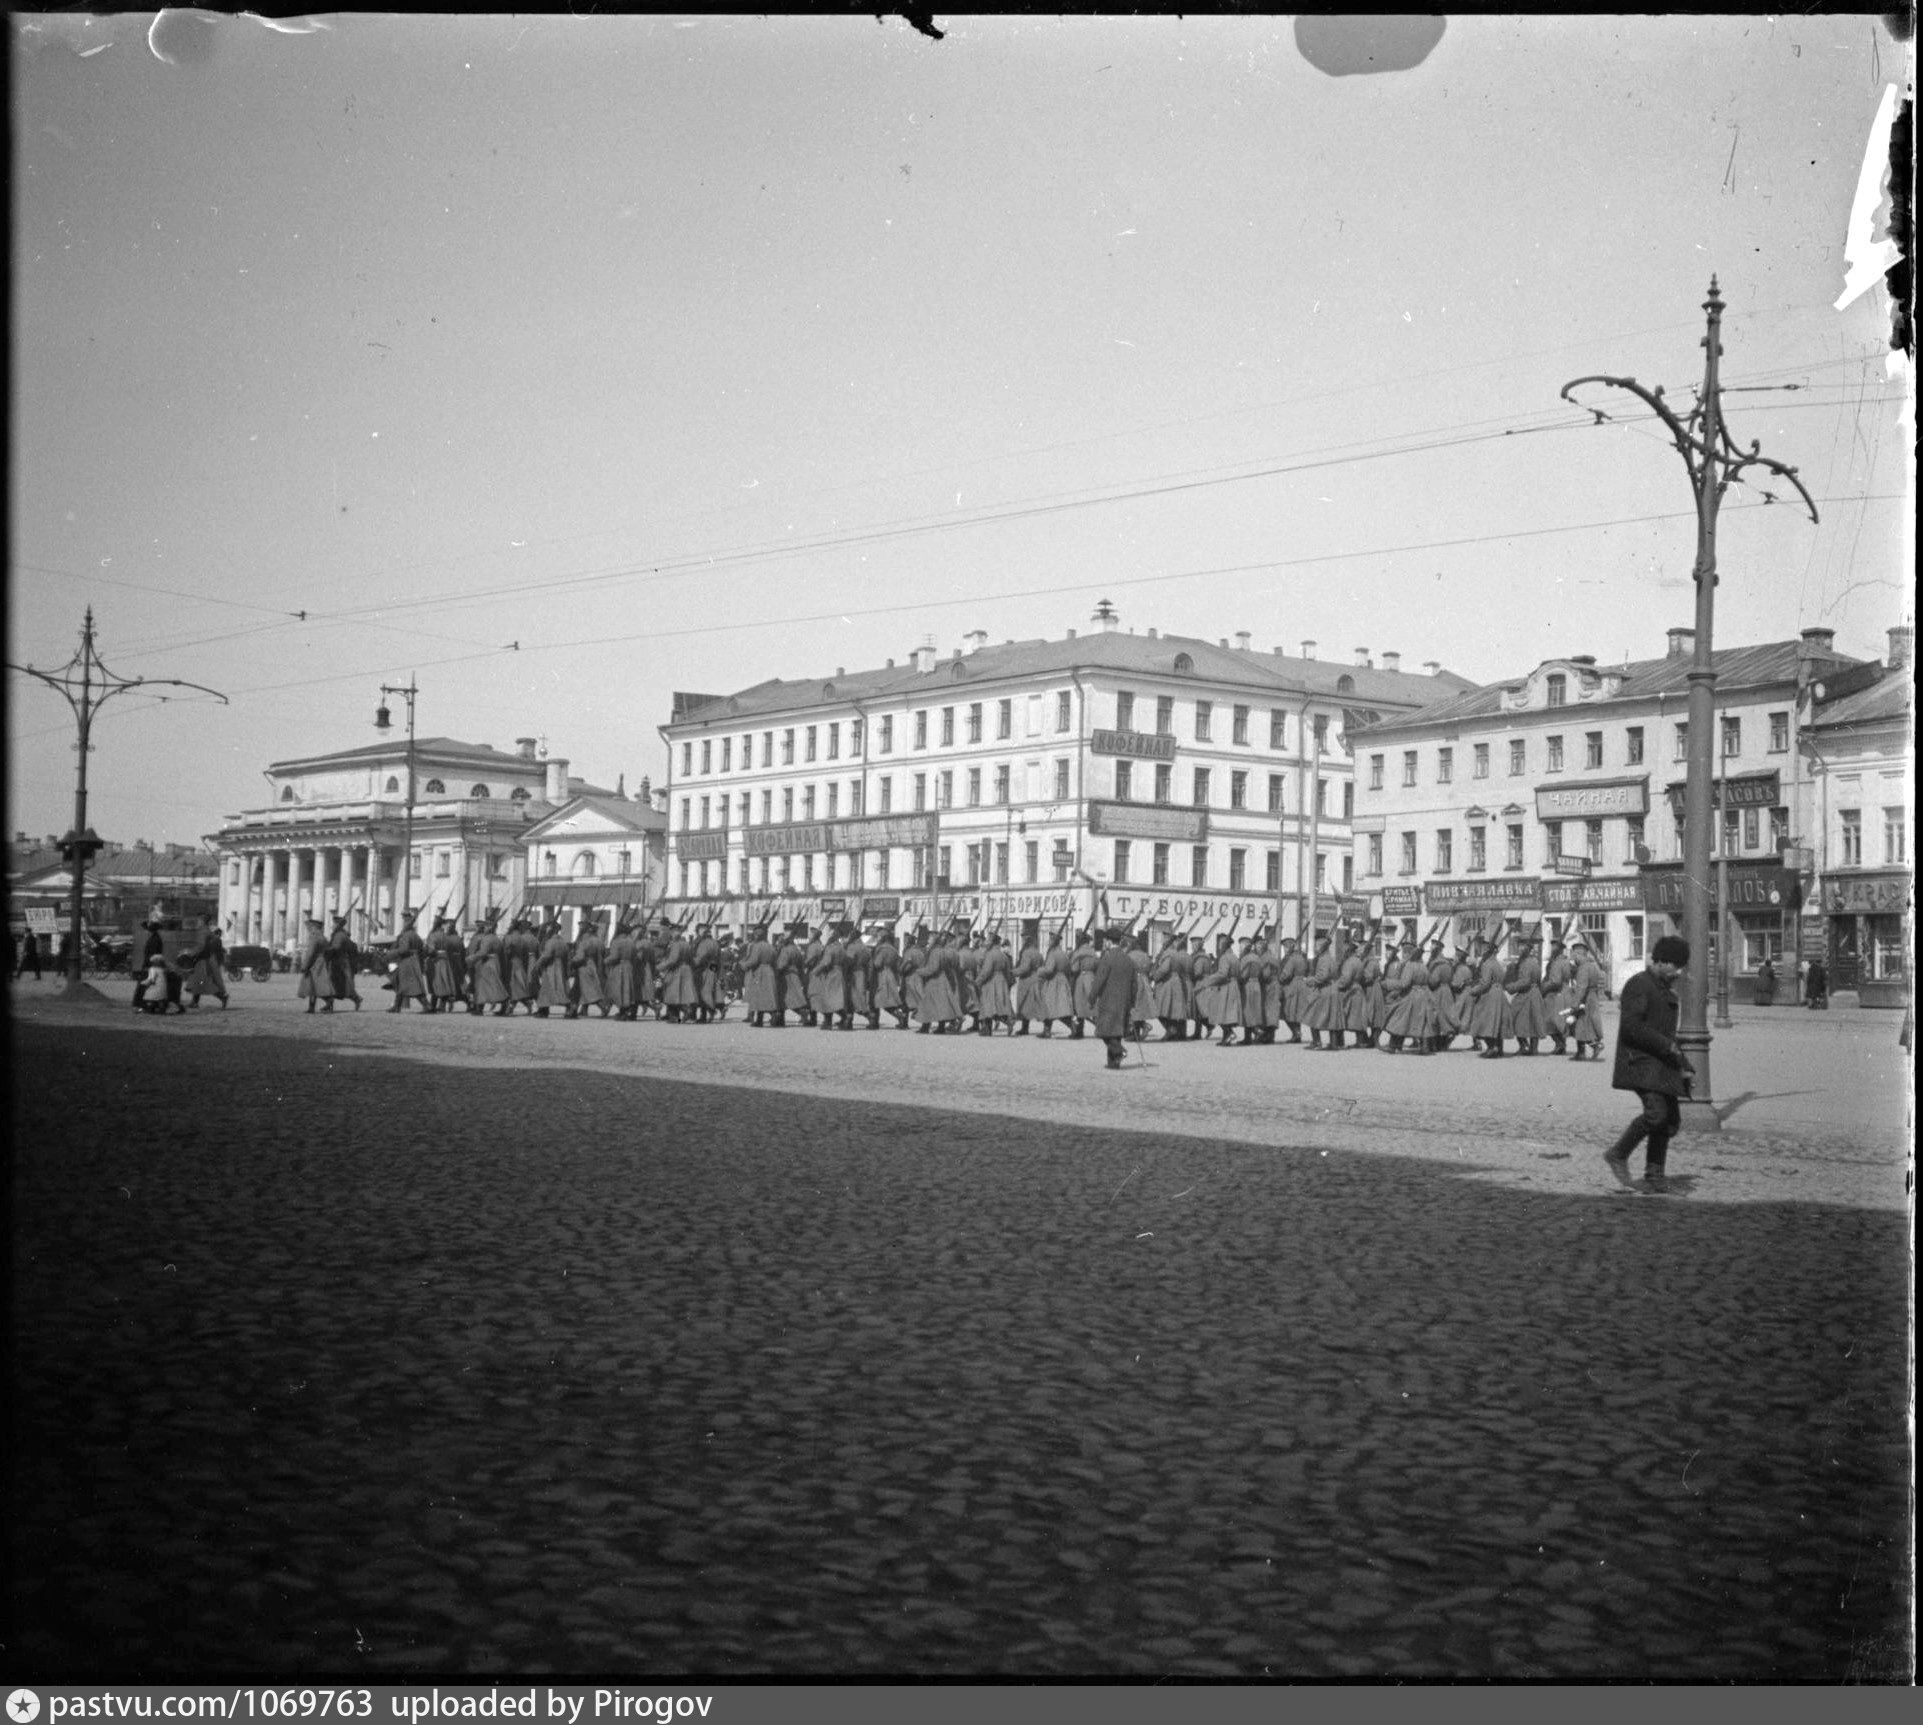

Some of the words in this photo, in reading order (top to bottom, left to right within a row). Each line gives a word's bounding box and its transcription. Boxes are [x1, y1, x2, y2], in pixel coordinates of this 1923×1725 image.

[1098, 733, 1171, 756] КОФЕЙНАЯ
[1551, 789, 1629, 806] ЧАЙНАЯ
[748, 828, 821, 854] КОФЕЙНАЯ
[1487, 883, 1533, 896] ЛАВКА
